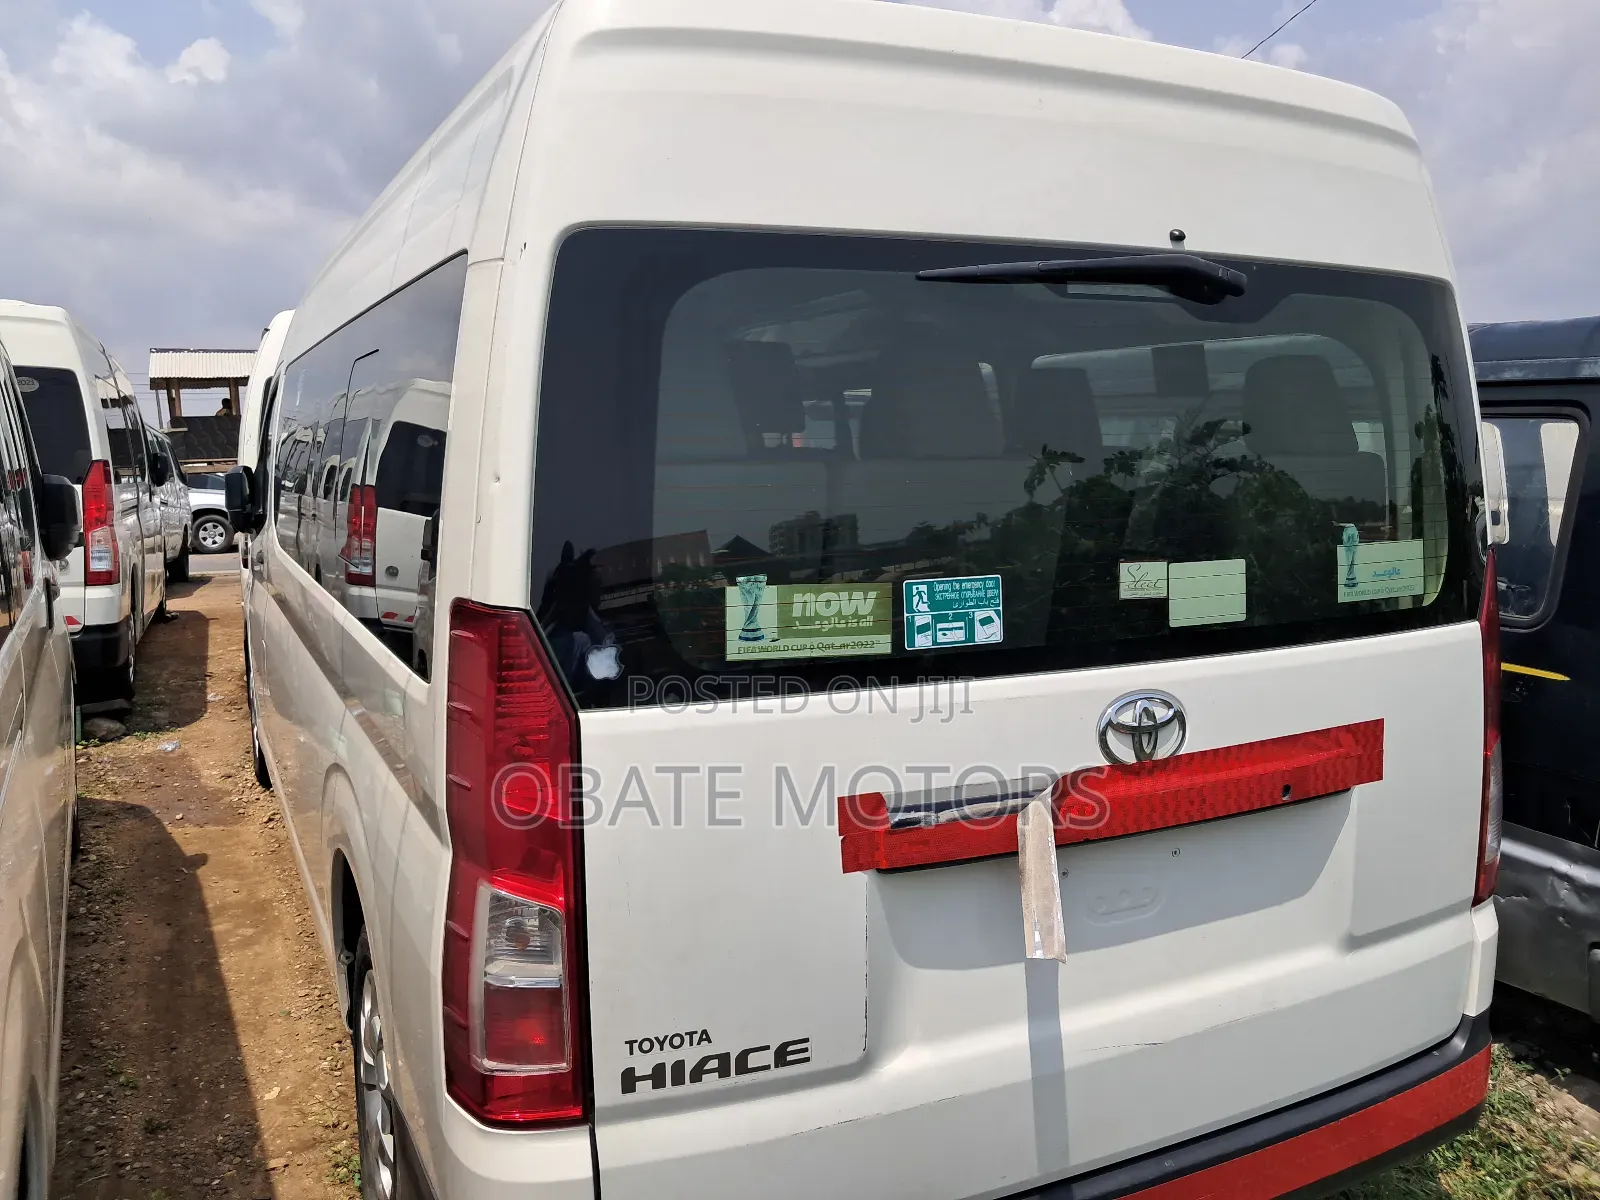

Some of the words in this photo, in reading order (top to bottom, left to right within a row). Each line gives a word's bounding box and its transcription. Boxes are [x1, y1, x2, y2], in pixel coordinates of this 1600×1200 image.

[933, 581, 952, 593] Opening
[952, 581, 960, 590] the
[792, 591, 877, 617] now
[859, 616, 874, 627] all
[737, 646, 757, 654] FIFA
[757, 645, 790, 653] WORLD
[790, 644, 807, 652] CUP
[624, 1029, 713, 1056] TOYOTA
[620, 1037, 811, 1095] HIACE
